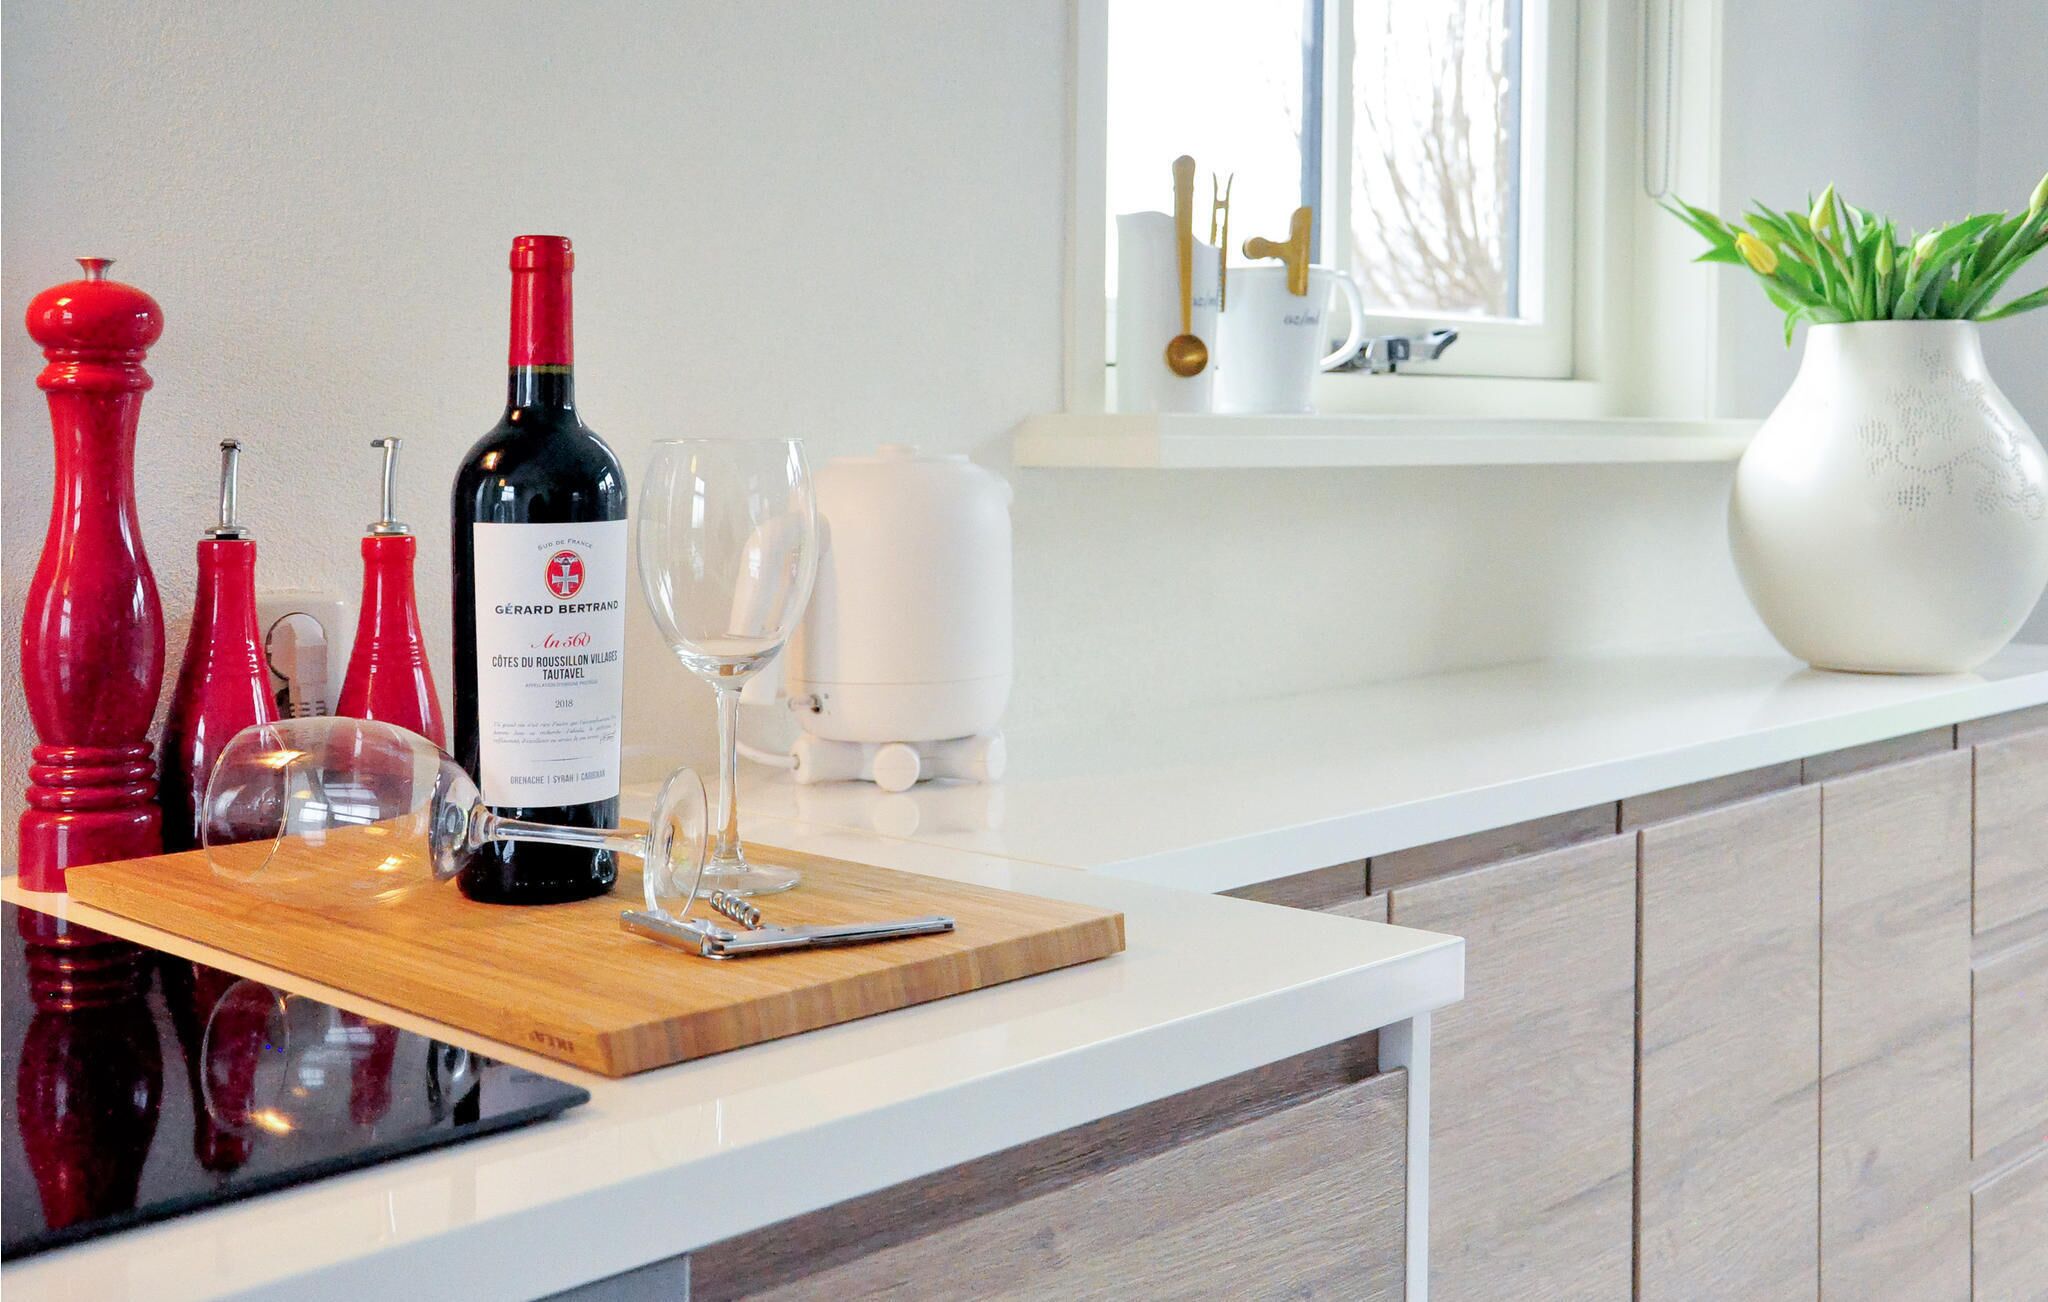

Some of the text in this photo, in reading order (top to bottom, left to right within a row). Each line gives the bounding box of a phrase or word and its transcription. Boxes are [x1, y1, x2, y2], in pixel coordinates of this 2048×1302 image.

[538, 542, 553, 551] SUD
[495, 600, 619, 615] GÉRARD BERTRAND
[492, 650, 618, 668] CÔTES DU ROUSSILLON VILLAGES
[543, 667, 585, 680] TAUTAVEL
[554, 699, 574, 709] 2018
[510, 775, 545, 785] GRENACHE
[552, 774, 574, 784] SYRAH
